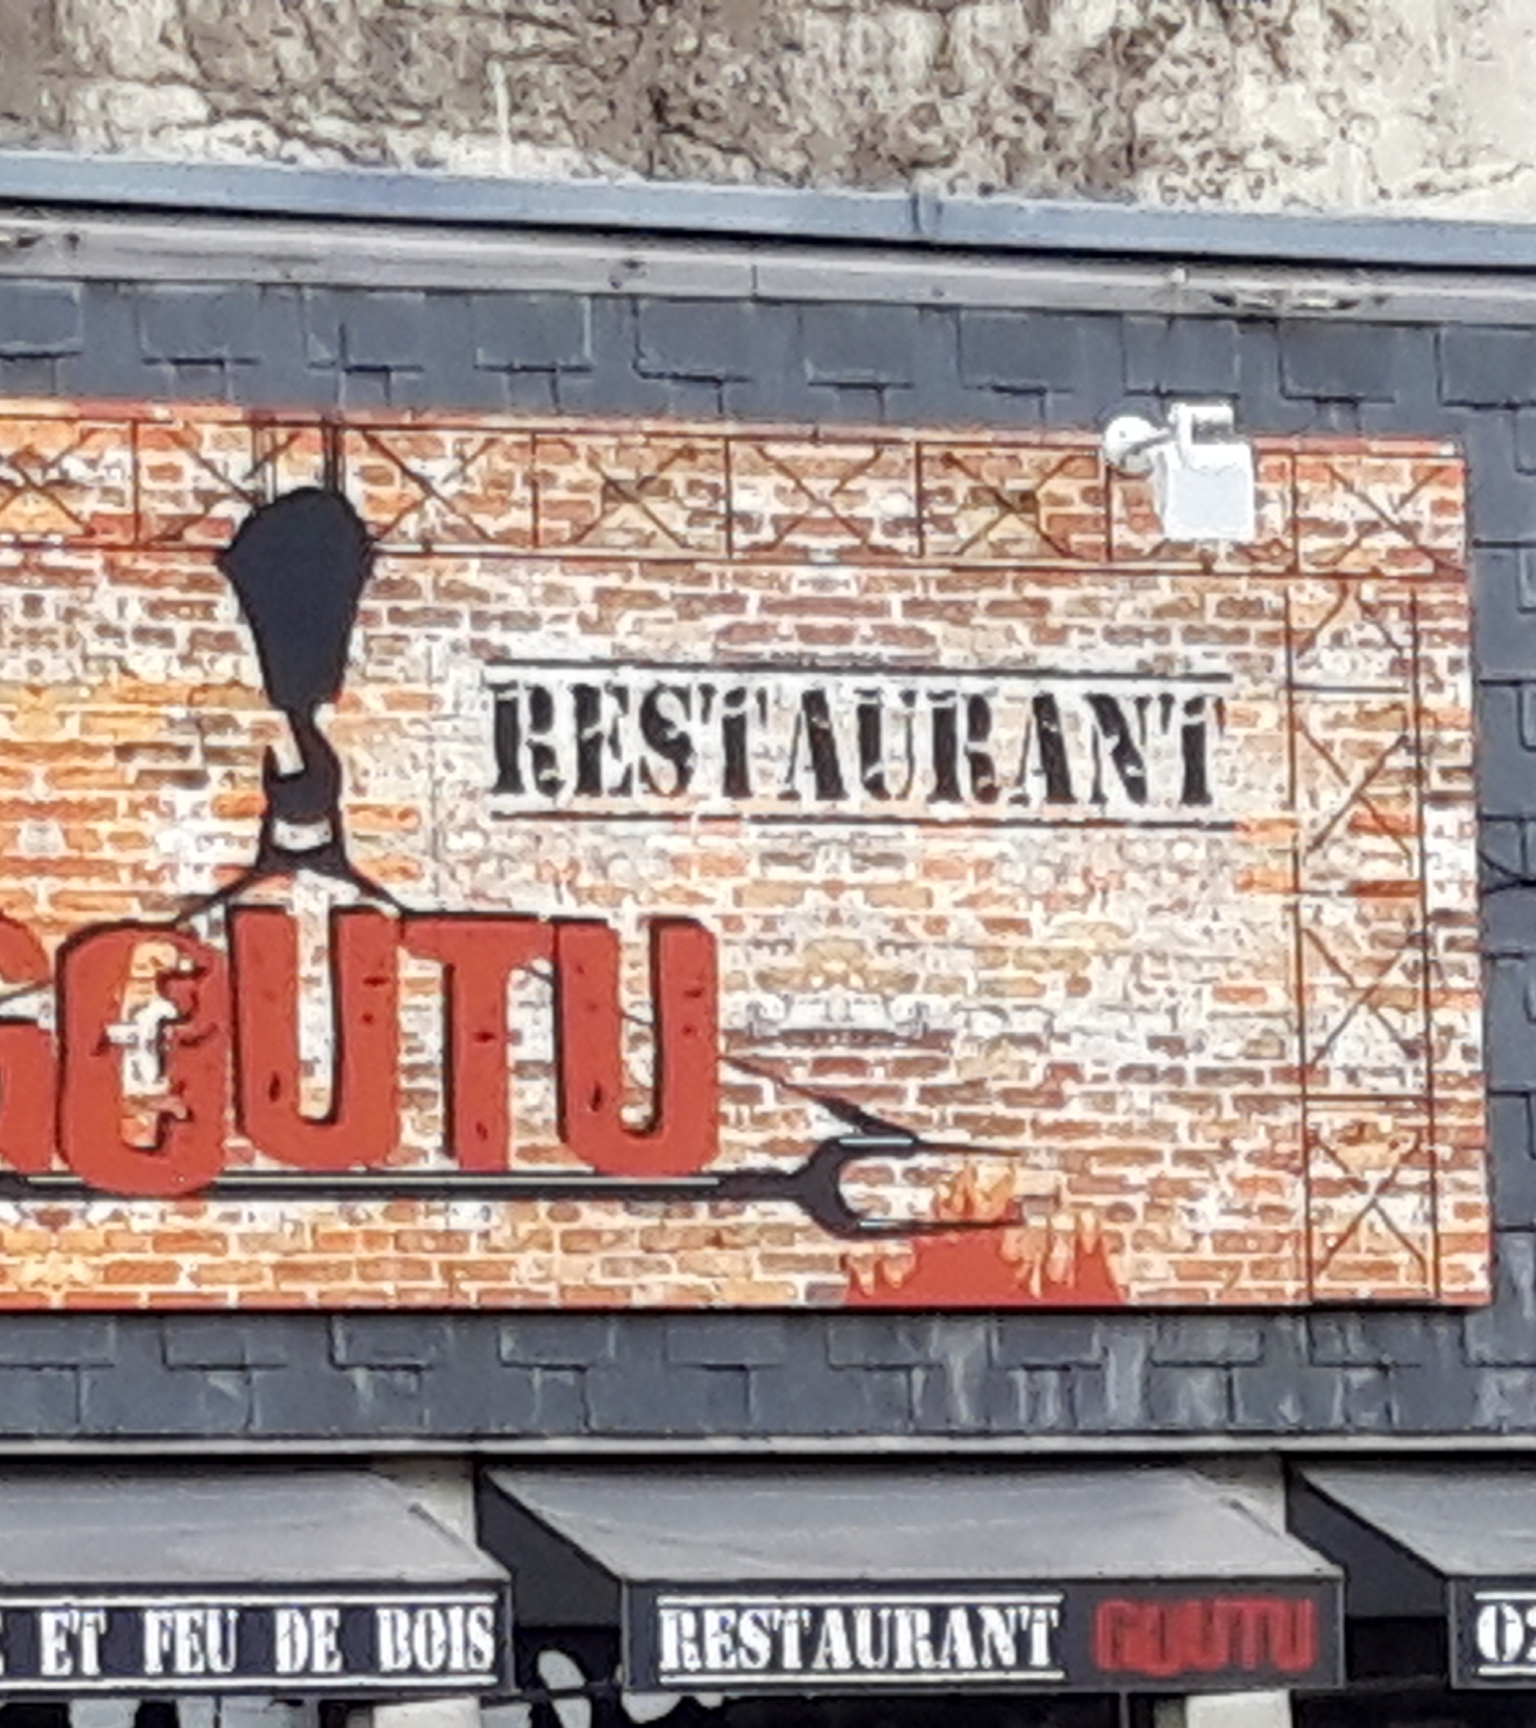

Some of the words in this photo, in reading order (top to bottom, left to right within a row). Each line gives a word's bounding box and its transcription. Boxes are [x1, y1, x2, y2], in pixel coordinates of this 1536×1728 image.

[488, 679, 1228, 804] RESTAURANT
[38, 1609, 107, 1678] ET
[143, 1608, 239, 1676] FEU
[275, 1607, 341, 1674] DE
[377, 1605, 497, 1674] BOIS
[658, 1607, 1061, 1673] RESTAURANT
